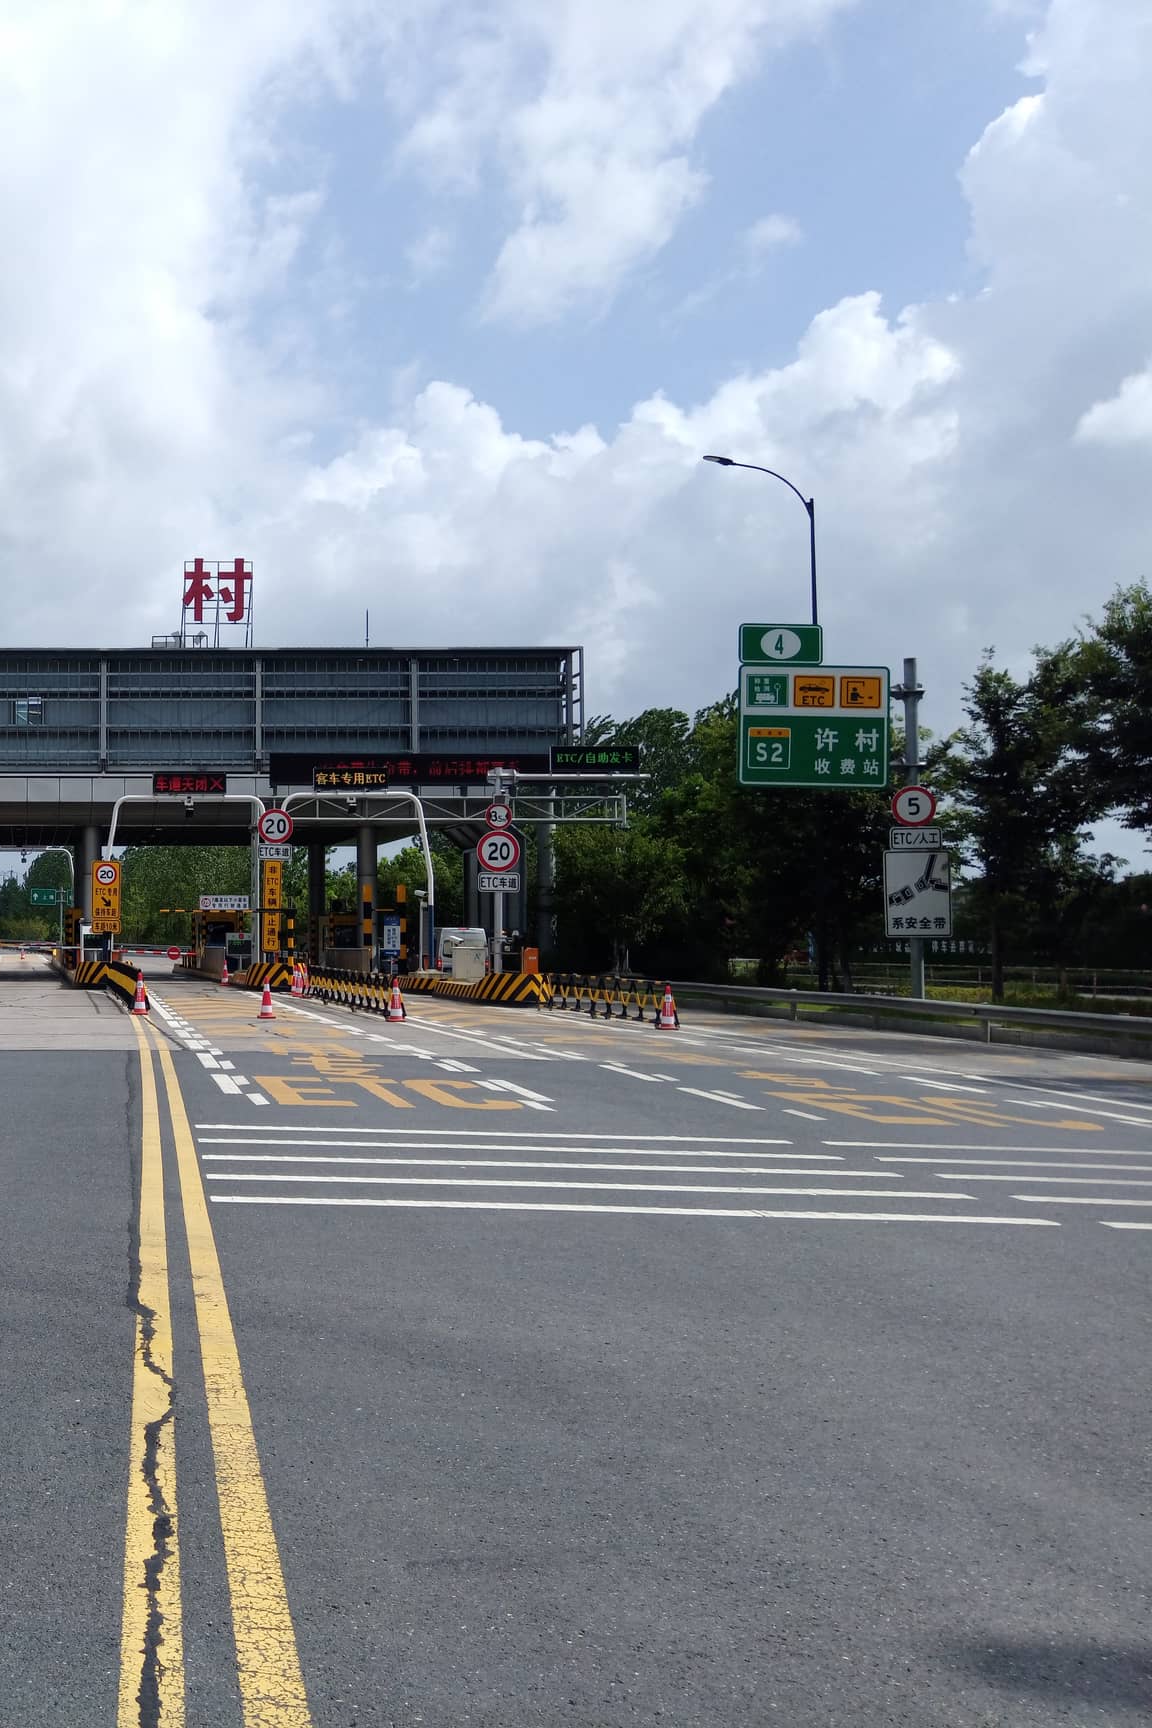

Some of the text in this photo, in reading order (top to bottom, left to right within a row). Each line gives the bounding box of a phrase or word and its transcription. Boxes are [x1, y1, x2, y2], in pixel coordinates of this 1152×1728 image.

[182, 557, 254, 622] 村
[774, 633, 784, 655] 4
[801, 695, 826, 706] ETC
[814, 727, 880, 753] 许村
[556, 751, 634, 764] ETC/自助发卡
[755, 742, 784, 762] S2
[814, 757, 880, 776] 收费站
[315, 772, 387, 785] 客车专用ETC
[907, 797, 921, 815] 5
[265, 818, 287, 834] 20
[893, 832, 939, 845] ETC/人工
[259, 847, 290, 857] ETC车道
[487, 842, 510, 861] 20
[99, 870, 114, 879] 20
[480, 876, 517, 888] ETC车道
[892, 917, 947, 930] 系安全带
[252, 1075, 525, 1111] ETC
[765, 1091, 1106, 1131] ETC
